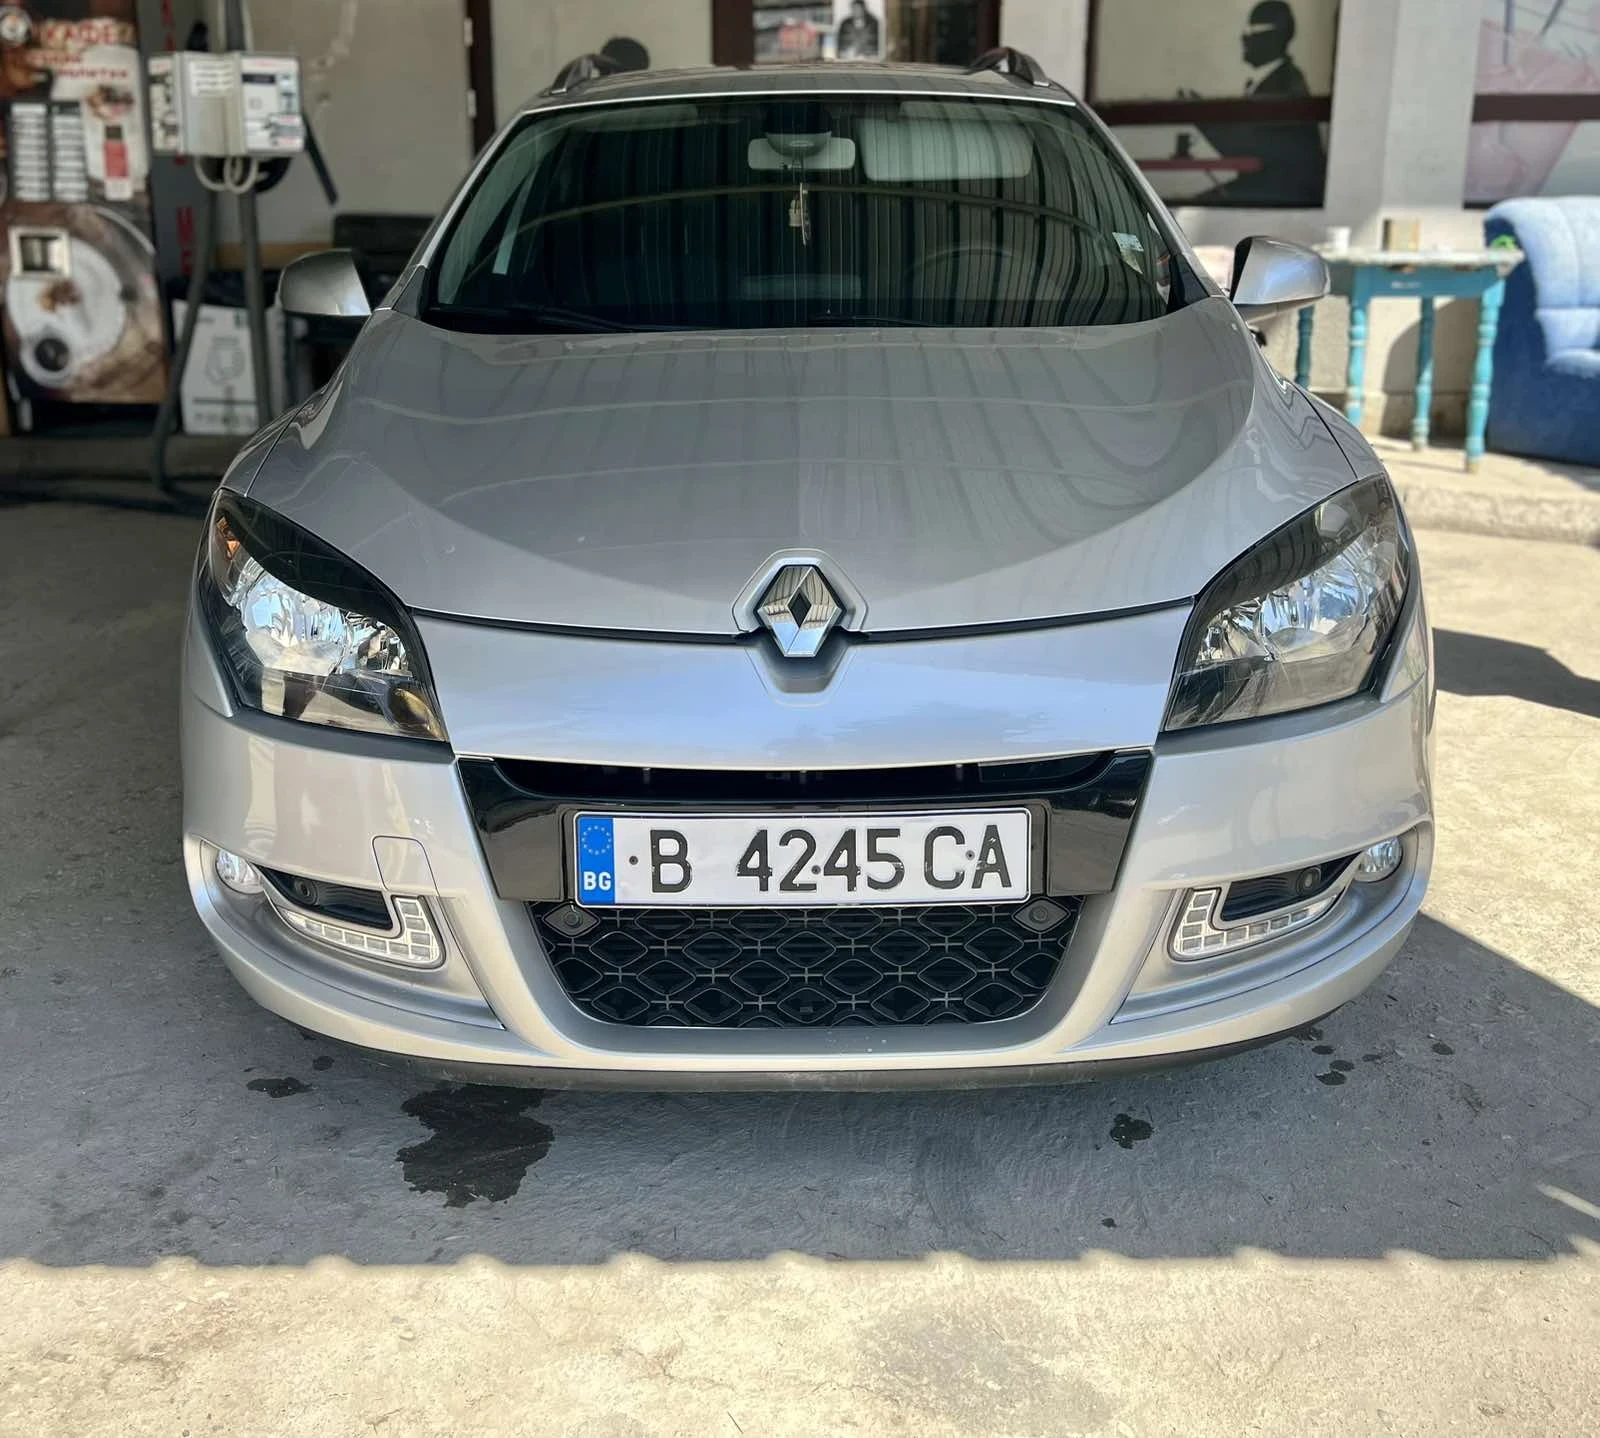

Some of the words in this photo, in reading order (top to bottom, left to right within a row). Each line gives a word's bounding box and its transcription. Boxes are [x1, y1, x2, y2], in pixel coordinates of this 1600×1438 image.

[583, 870, 612, 891] BG
[649, 828, 691, 893] B
[736, 827, 905, 893] 4245
[923, 823, 1013, 889] CA
